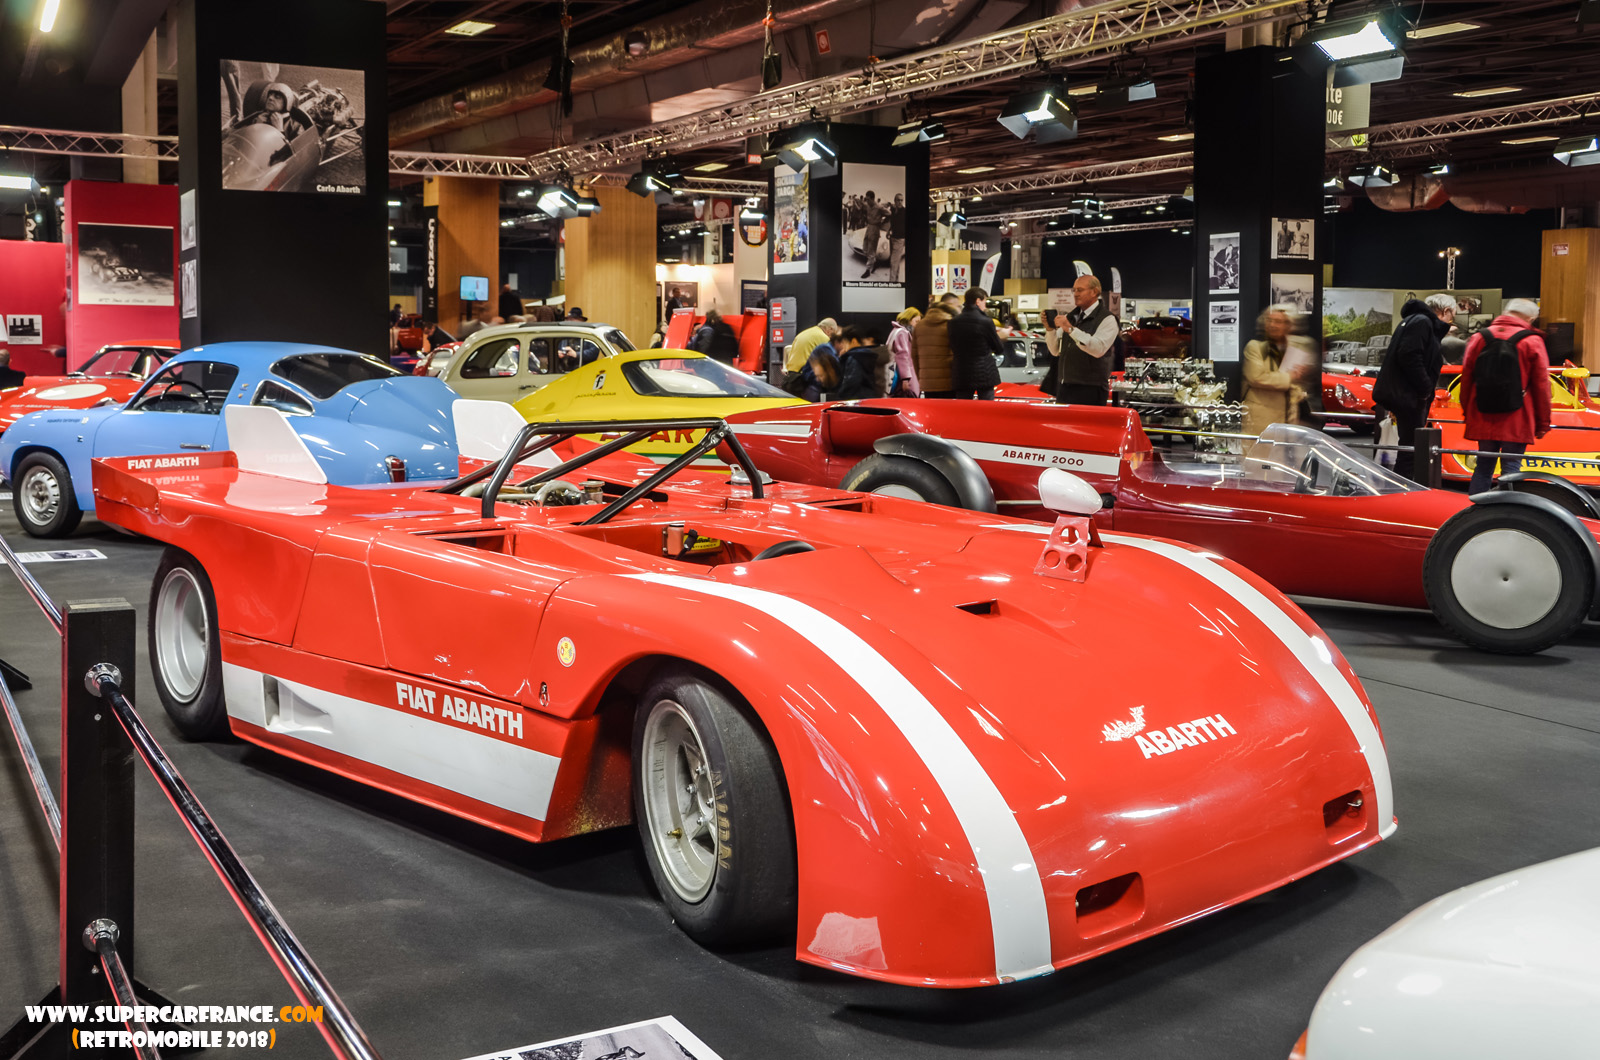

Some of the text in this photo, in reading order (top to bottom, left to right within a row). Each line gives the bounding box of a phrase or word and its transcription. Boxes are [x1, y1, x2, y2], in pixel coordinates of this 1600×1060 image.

[775, 175, 795, 187] SICILIA
[316, 184, 361, 194] Carlo Abarth
[776, 186, 795, 197] TARGA
[968, 240, 987, 251] Clubs
[127, 456, 199, 470] FIAT ABARTH
[1002, 449, 1084, 467] ABARTH 2000
[1521, 459, 1596, 469] BARTH
[396, 681, 523, 739] FIAT ABARTH
[1133, 713, 1238, 760] ABARTH
